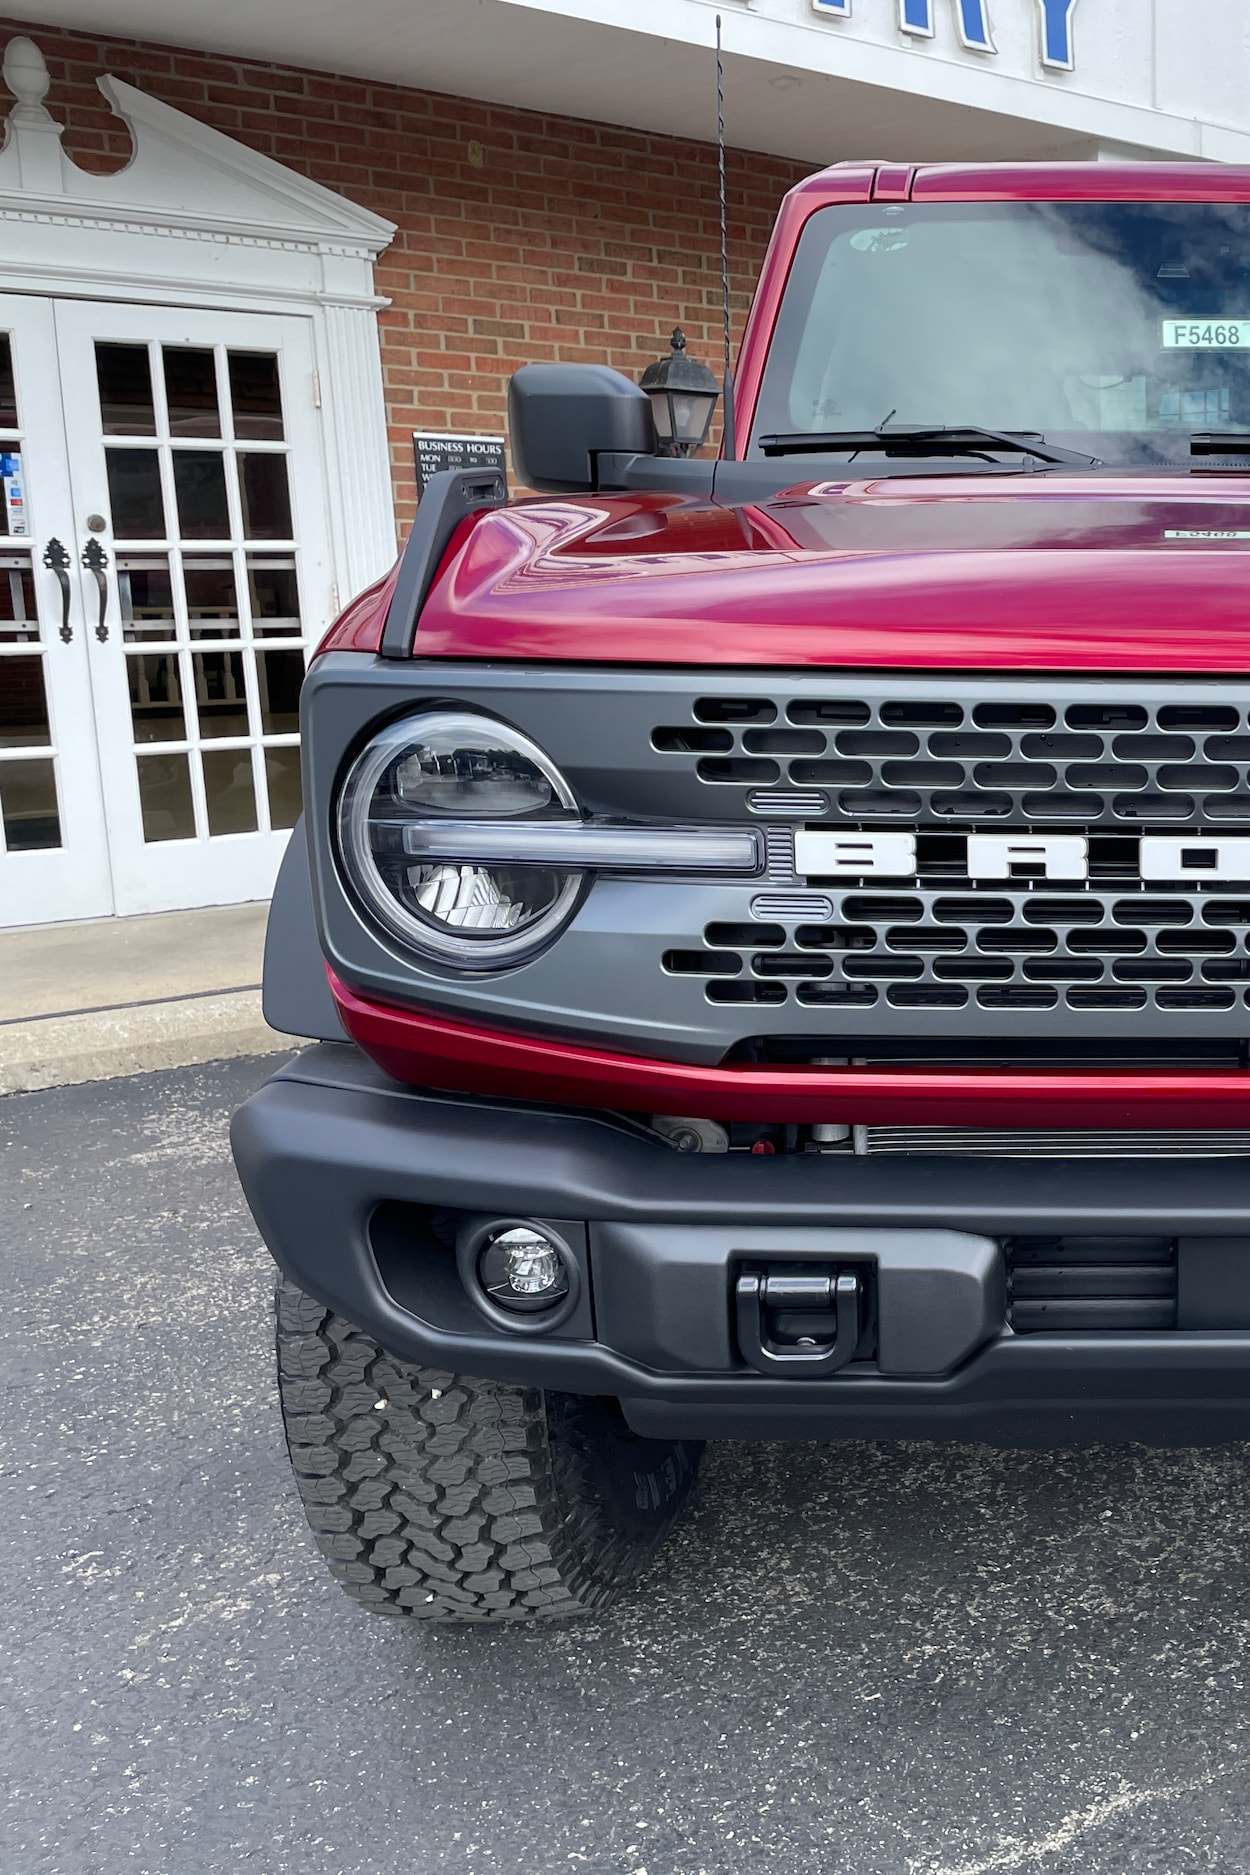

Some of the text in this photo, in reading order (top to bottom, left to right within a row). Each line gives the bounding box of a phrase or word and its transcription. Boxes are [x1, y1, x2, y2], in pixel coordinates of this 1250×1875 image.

[1173, 325, 1240, 345] F5468
[418, 440, 502, 454] BUSINESS HOURS
[420, 454, 441, 462] MON
[421, 463, 436, 472] TUE
